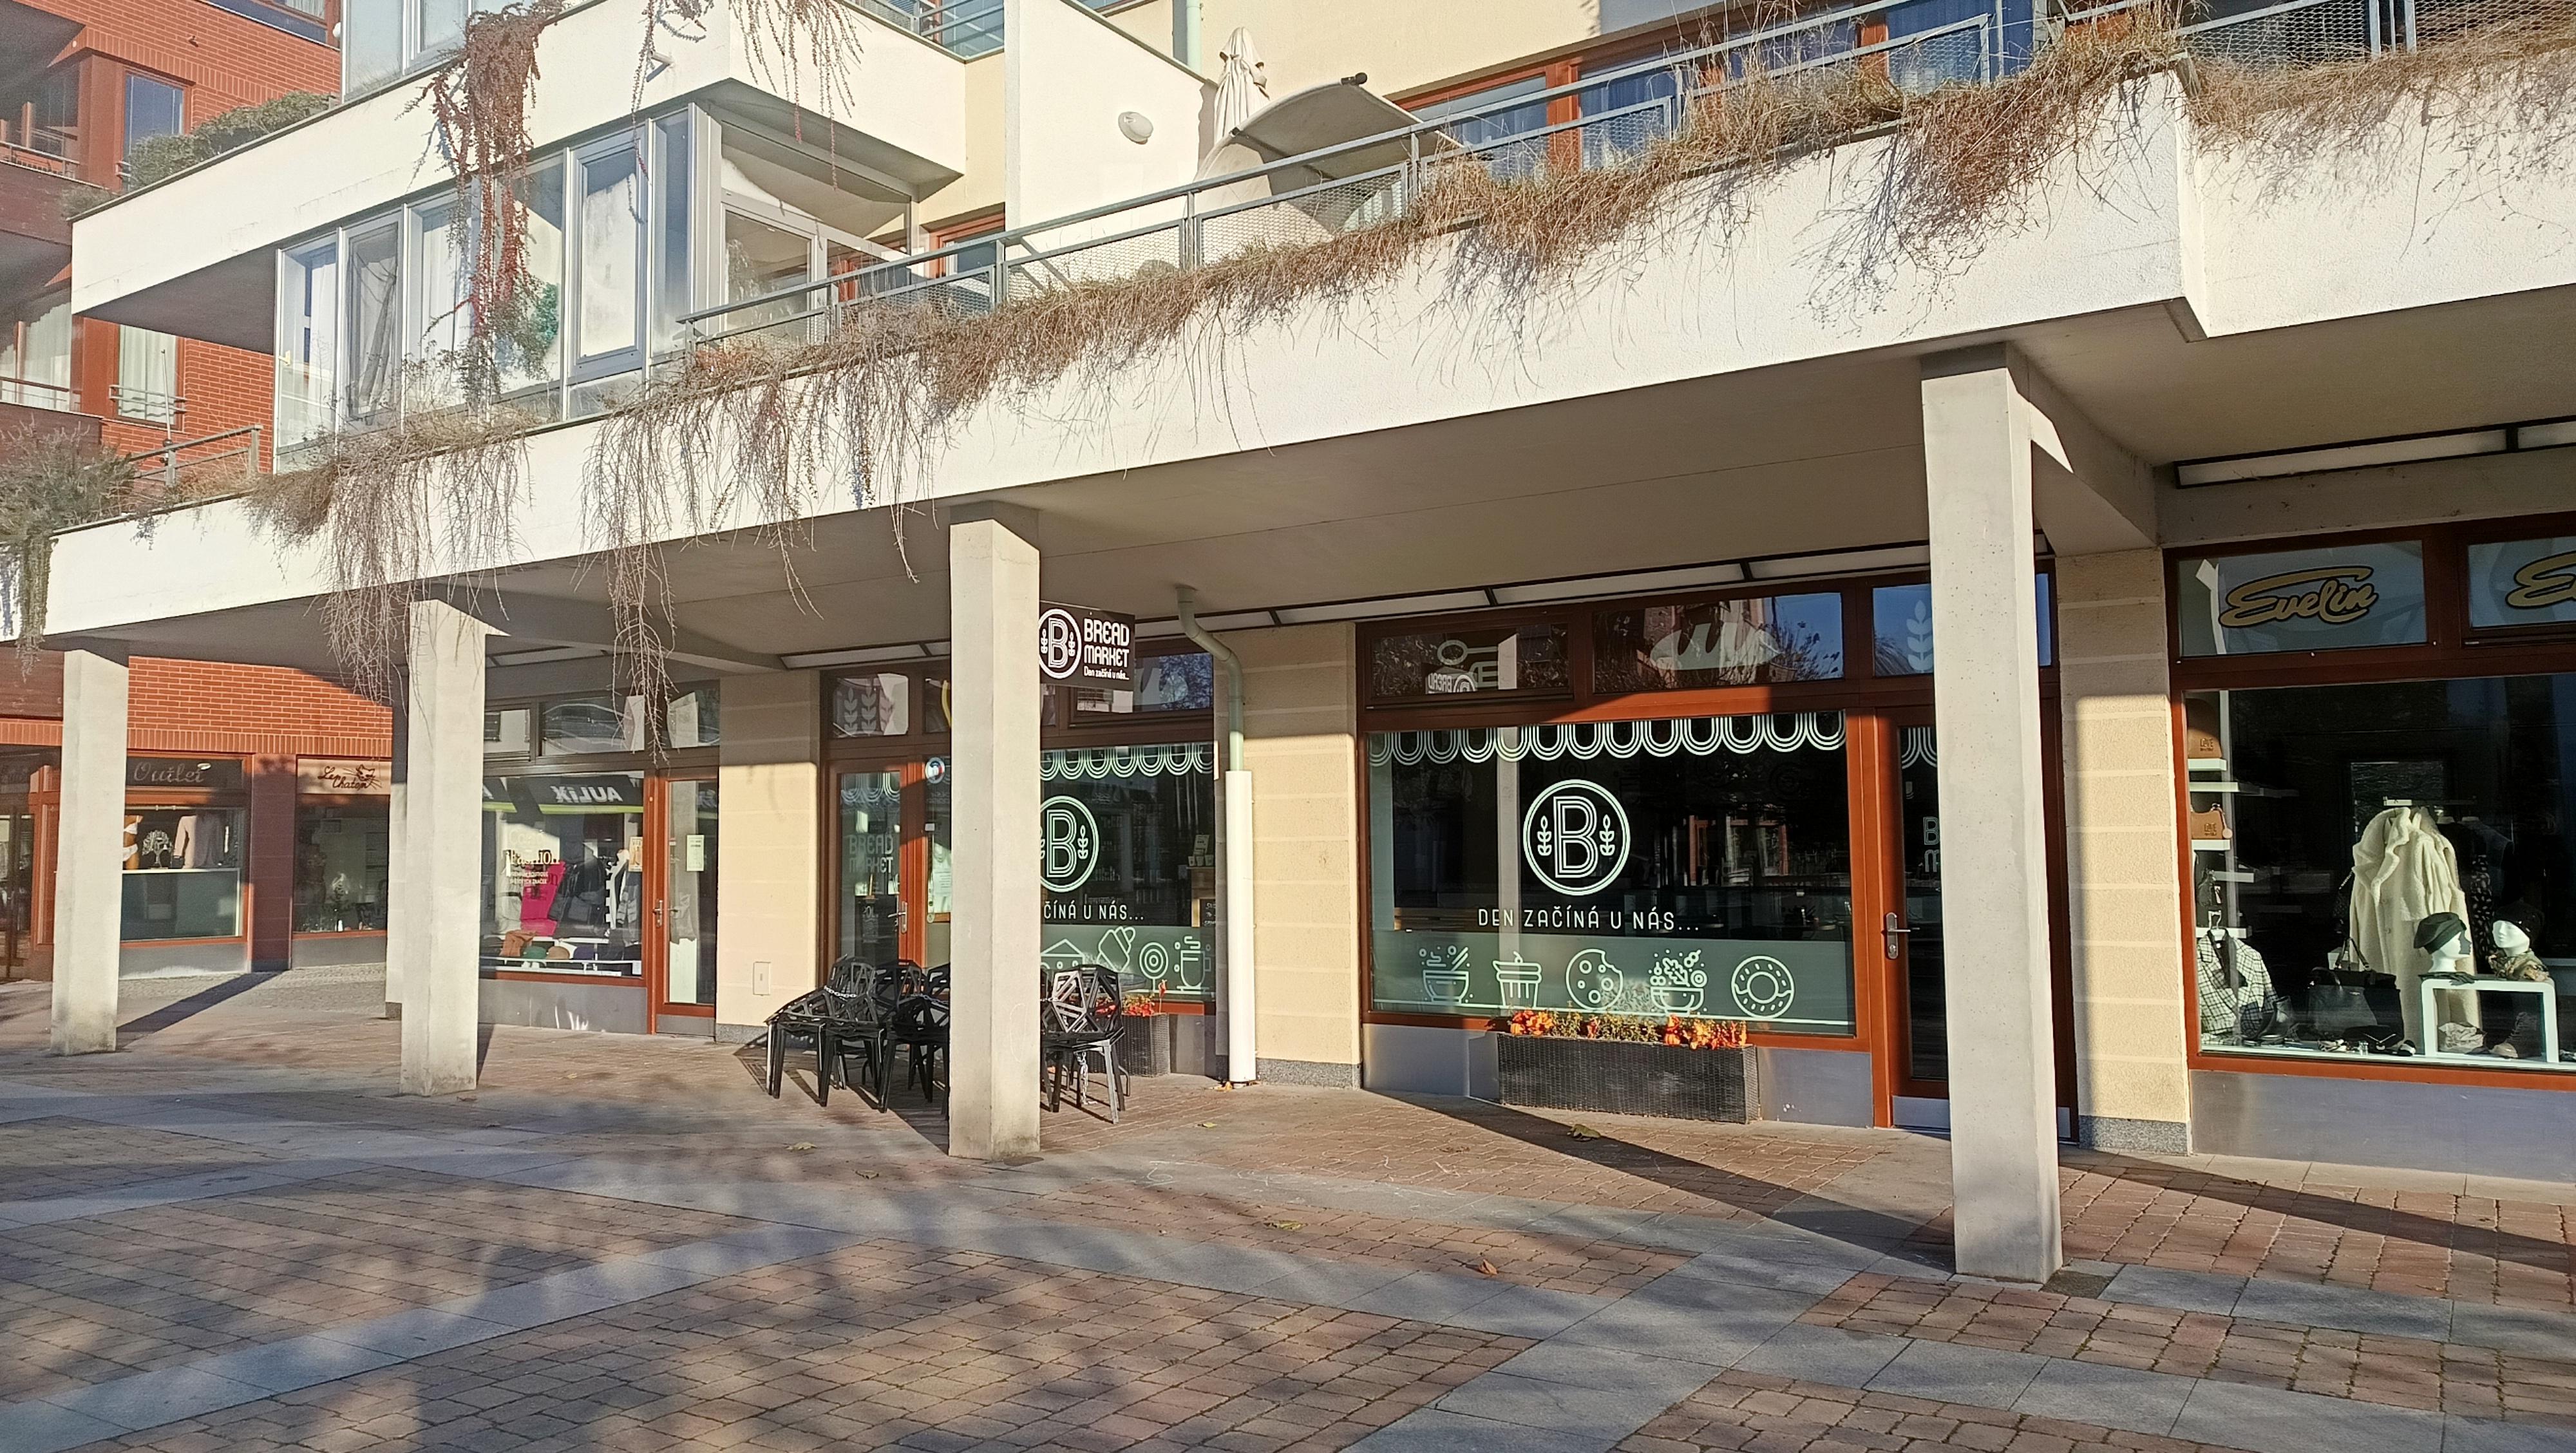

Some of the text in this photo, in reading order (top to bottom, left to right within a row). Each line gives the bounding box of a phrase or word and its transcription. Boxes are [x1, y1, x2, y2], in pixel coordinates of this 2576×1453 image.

[2219, 565, 2379, 628] Evelin
[1084, 618, 1130, 646] BREAD
[1084, 645, 1130, 667] MARKET
[849, 834, 893, 855] BREAD
[849, 857, 893, 873] MRKET
[1043, 900, 1144, 920] ČÍNÁ U NÁS...
[1478, 904, 1700, 931] DEN ZAČÍNÁ U NÁS...
